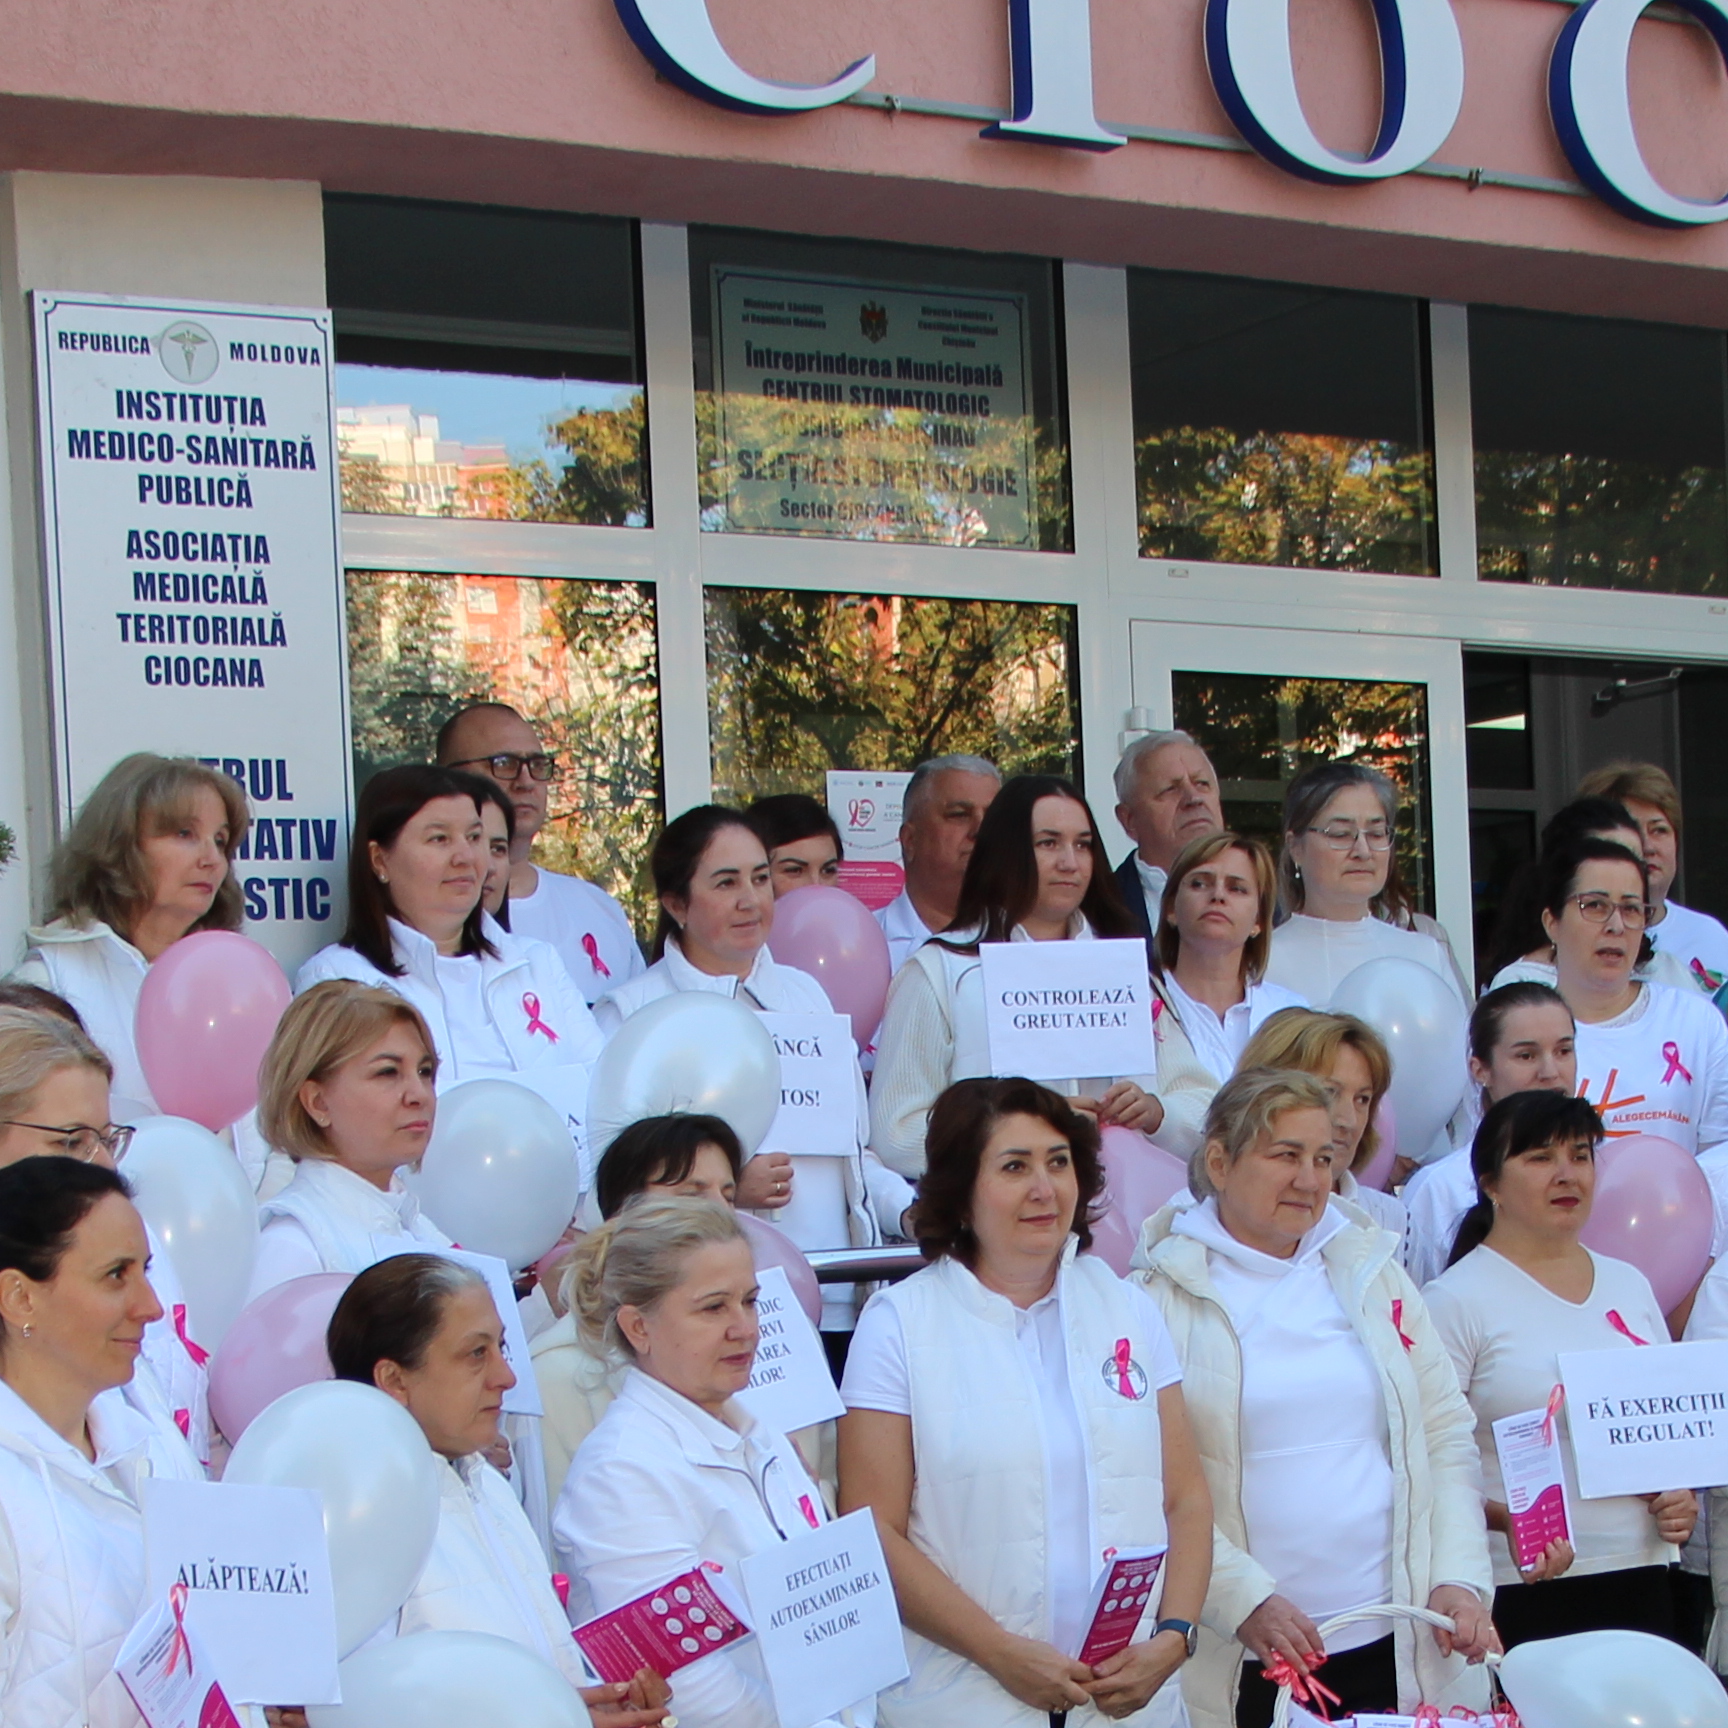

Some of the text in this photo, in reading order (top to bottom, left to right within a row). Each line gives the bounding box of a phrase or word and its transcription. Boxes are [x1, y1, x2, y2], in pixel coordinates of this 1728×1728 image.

[58, 331, 321, 366] REPUBLICA MOLDOVA
[745, 340, 1003, 389] Întreprinderea Municipală
[115, 389, 266, 433] INSTITUȚIA
[849, 384, 990, 417] STOMATOLOGIC
[67, 428, 316, 471] MEDICO-SANITARĂ
[137, 471, 253, 508] PUBLICĂ
[780, 498, 833, 520] Sector
[126, 529, 270, 572] ASOCIAȚIA
[132, 569, 268, 606] MEDICALĂ
[115, 611, 288, 648] TERITORIALĂ
[144, 655, 265, 688] CIOCANA
[1001, 984, 1136, 1008] CONTROLEAZĂ
[1013, 1011, 1128, 1031] GREUTATEA!
[772, 1033, 823, 1057] ÂNCĂ
[780, 1088, 821, 1107] TOS!
[1587, 1392, 1727, 1420] FĂ EXERCIȚII
[1608, 1419, 1716, 1445] REGULAT!
[176, 1557, 310, 1595] ALĂPTEAZĂ!
[784, 1551, 852, 1593] EFECTUAȚI
[769, 1570, 881, 1631] AUTOEXAMINAREA
[803, 1609, 862, 1647] SÂNILOR!
